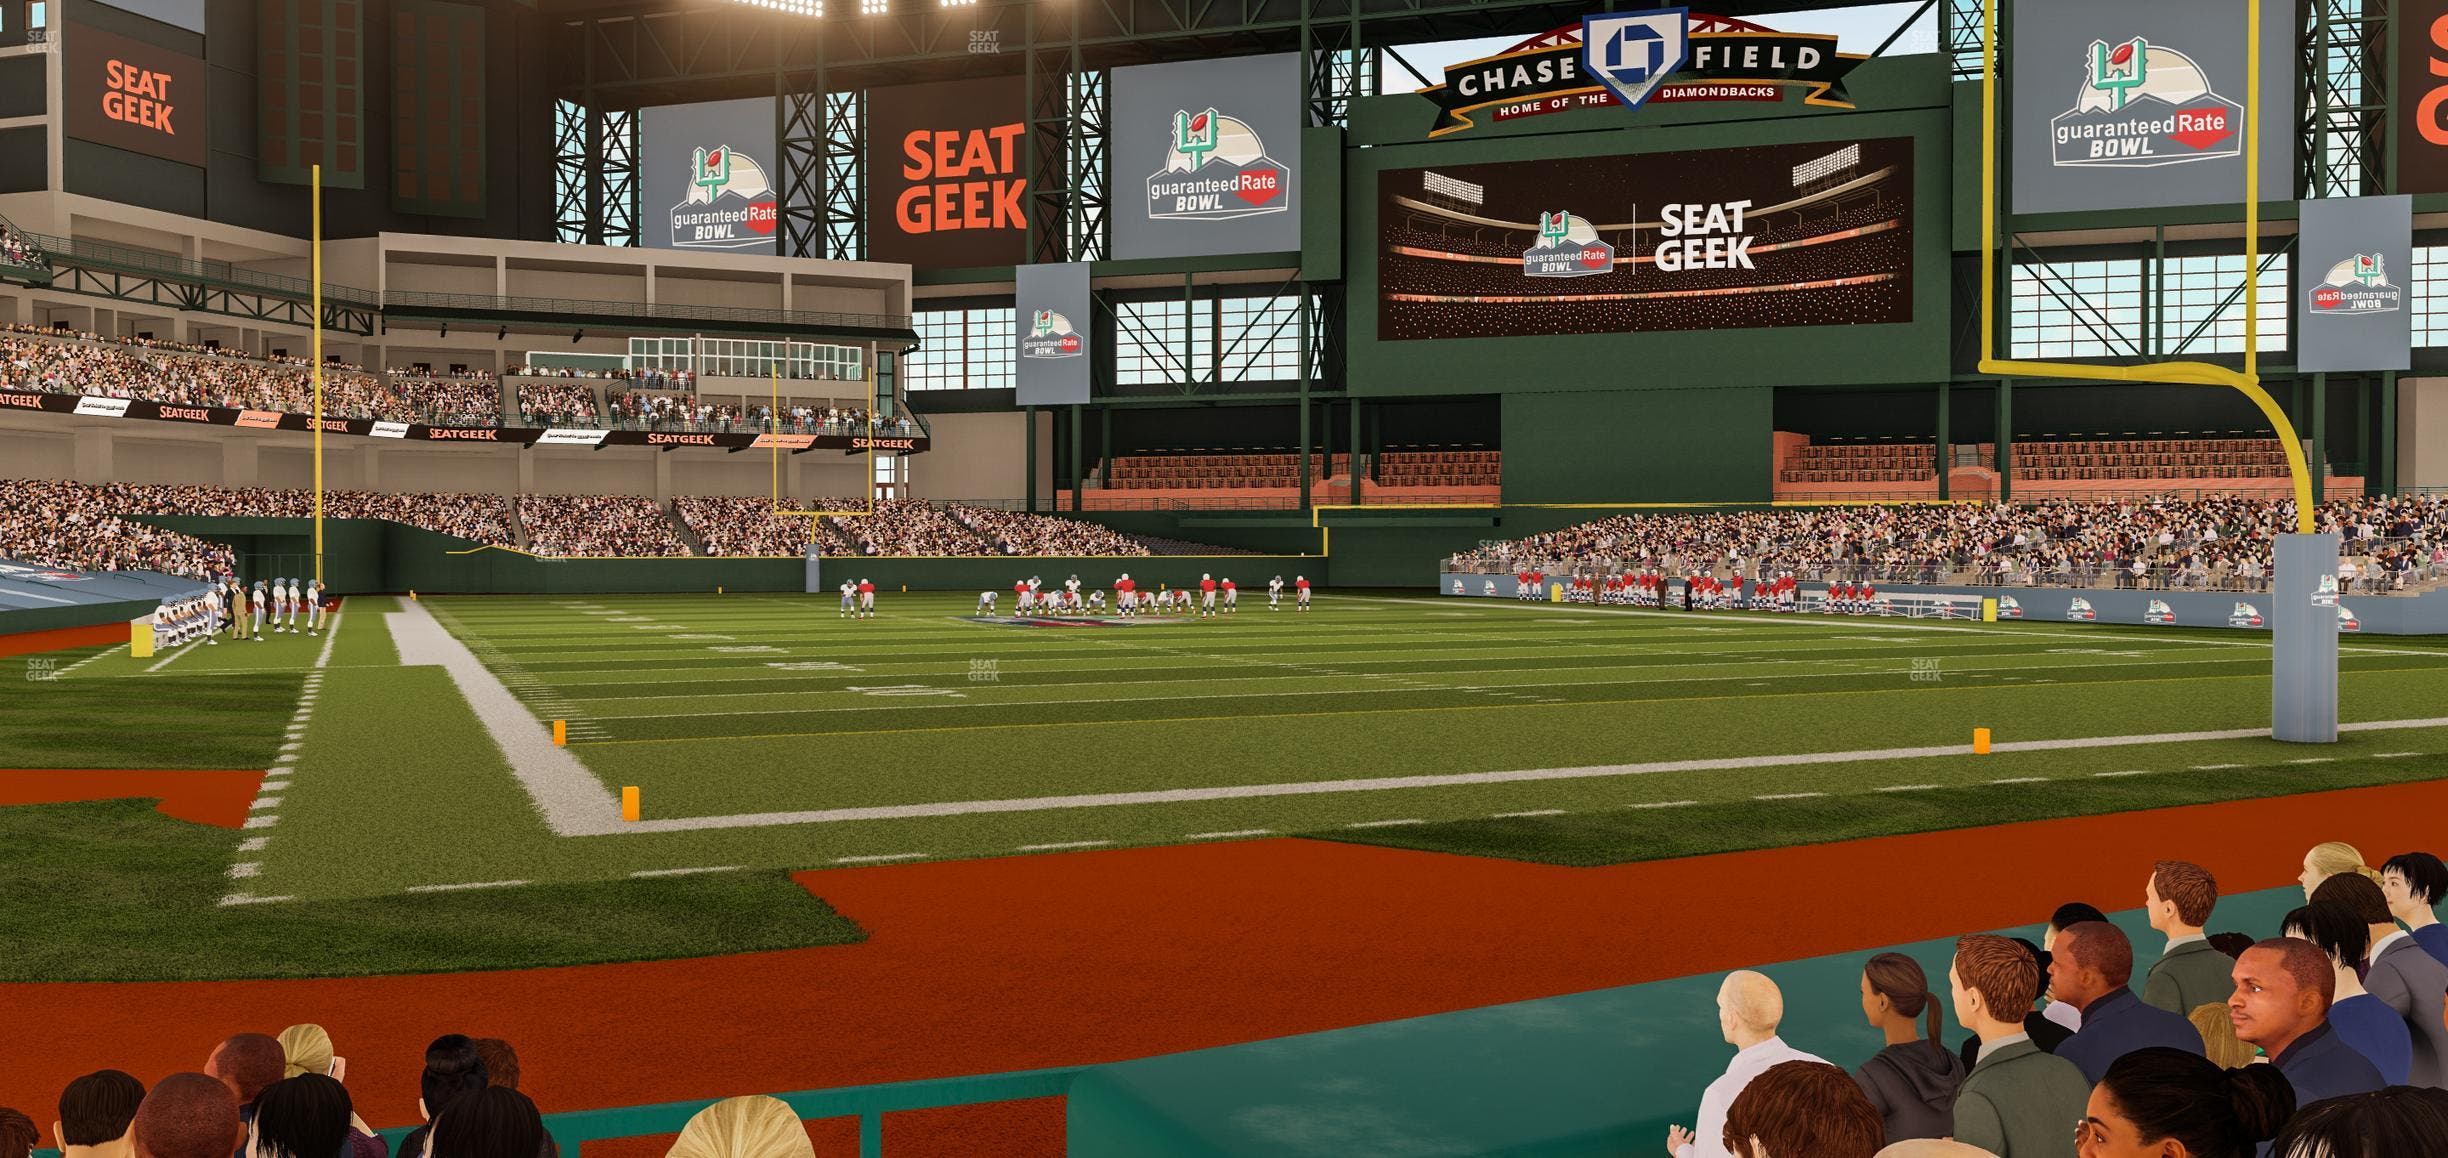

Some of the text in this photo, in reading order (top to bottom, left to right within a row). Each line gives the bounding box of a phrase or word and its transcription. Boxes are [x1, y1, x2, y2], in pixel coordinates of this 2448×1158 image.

[107, 60, 171, 101] SEAT
[1458, 46, 1821, 97] CHASE FIELD
[1500, 87, 1775, 116] HOME OF THE DIAMONDBACKS
[103, 91, 175, 135] GEEK
[2056, 114, 2225, 144] guaranteed Rate
[903, 122, 1025, 181] SEAT
[2089, 137, 2154, 158] BOWL
[1151, 175, 1276, 200] guaranteed Rate
[896, 178, 1027, 234] GEEK
[1176, 194, 1223, 212] BOWL
[674, 207, 748, 229] guaranteed
[1661, 199, 1752, 237] SEAT
[695, 224, 735, 240] BOWL
[1526, 251, 1606, 265] guaranteed Rate
[1655, 236, 1755, 272] GEEK
[1541, 262, 1573, 272] BOWL
[1024, 338, 1078, 349] guaranteed Rate
[1035, 347, 1056, 355] BOWL
[160, 405, 209, 422] SEATGEEK
[306, 418, 348, 433] SETGEEK
[429, 428, 498, 440] SEATGEEK
[647, 433, 715, 445] SEATGEEK
